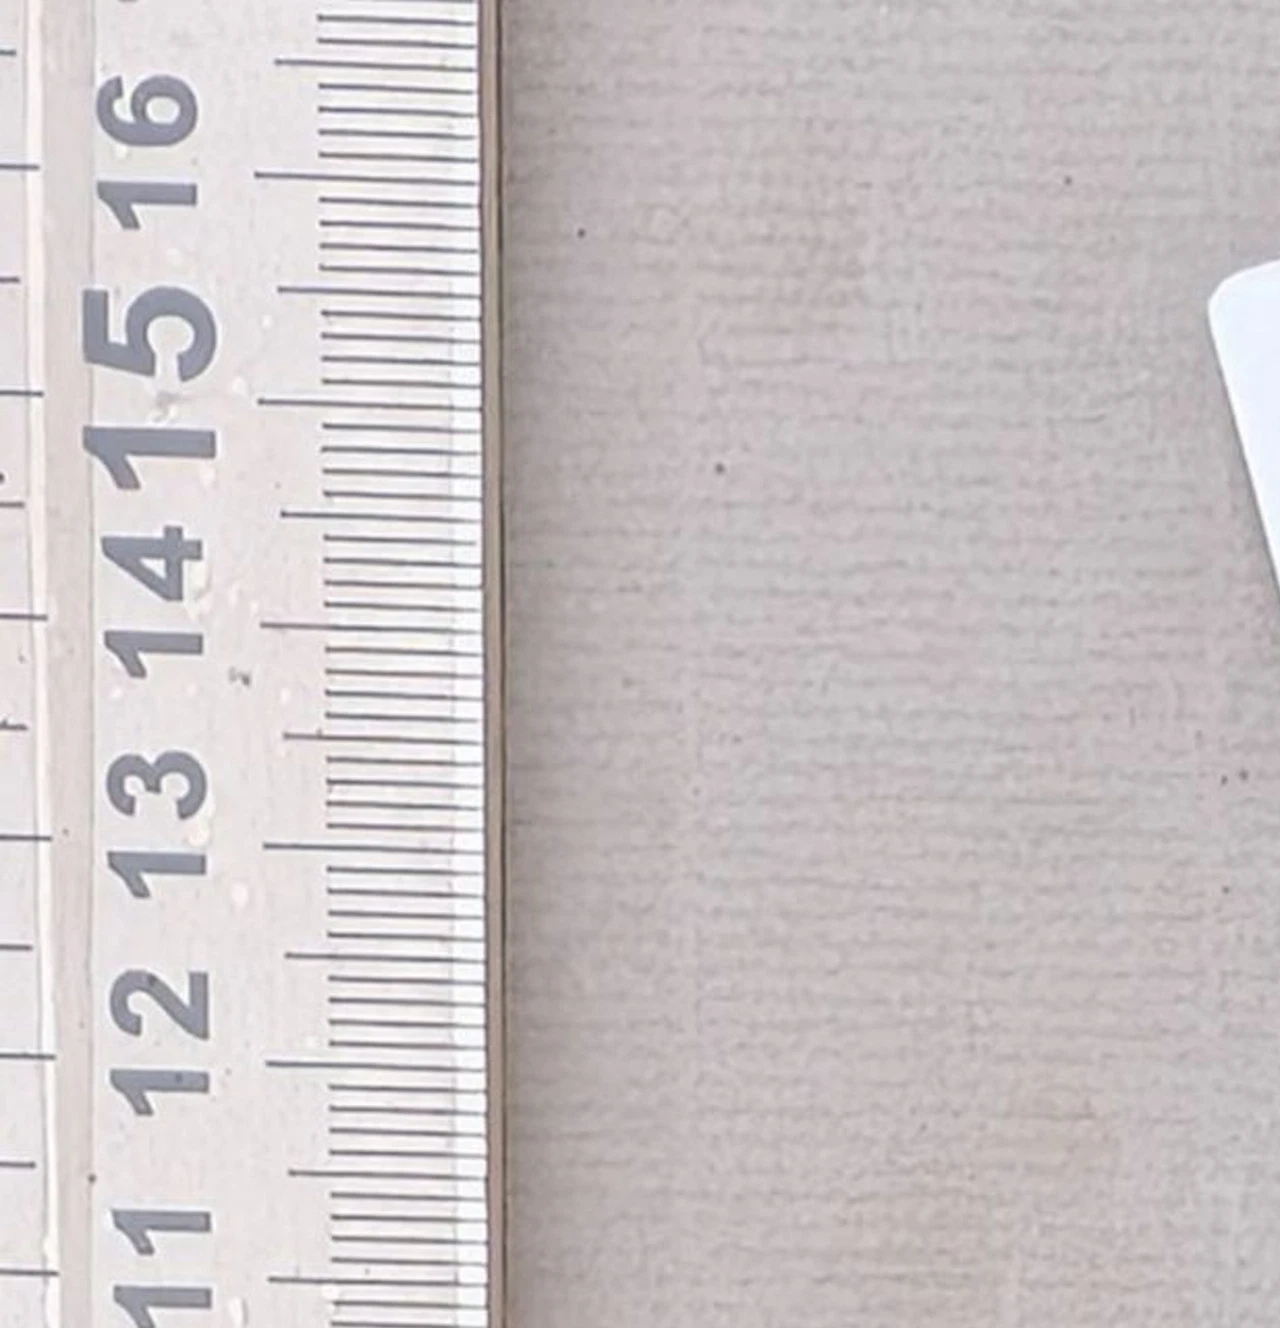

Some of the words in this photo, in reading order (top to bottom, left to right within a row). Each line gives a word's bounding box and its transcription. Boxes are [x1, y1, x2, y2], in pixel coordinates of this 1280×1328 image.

[95, 75, 199, 231] 16
[82, 286, 217, 491] 15
[100, 525, 204, 680] 14
[105, 751, 208, 900] 13
[109, 969, 210, 1117] 12
